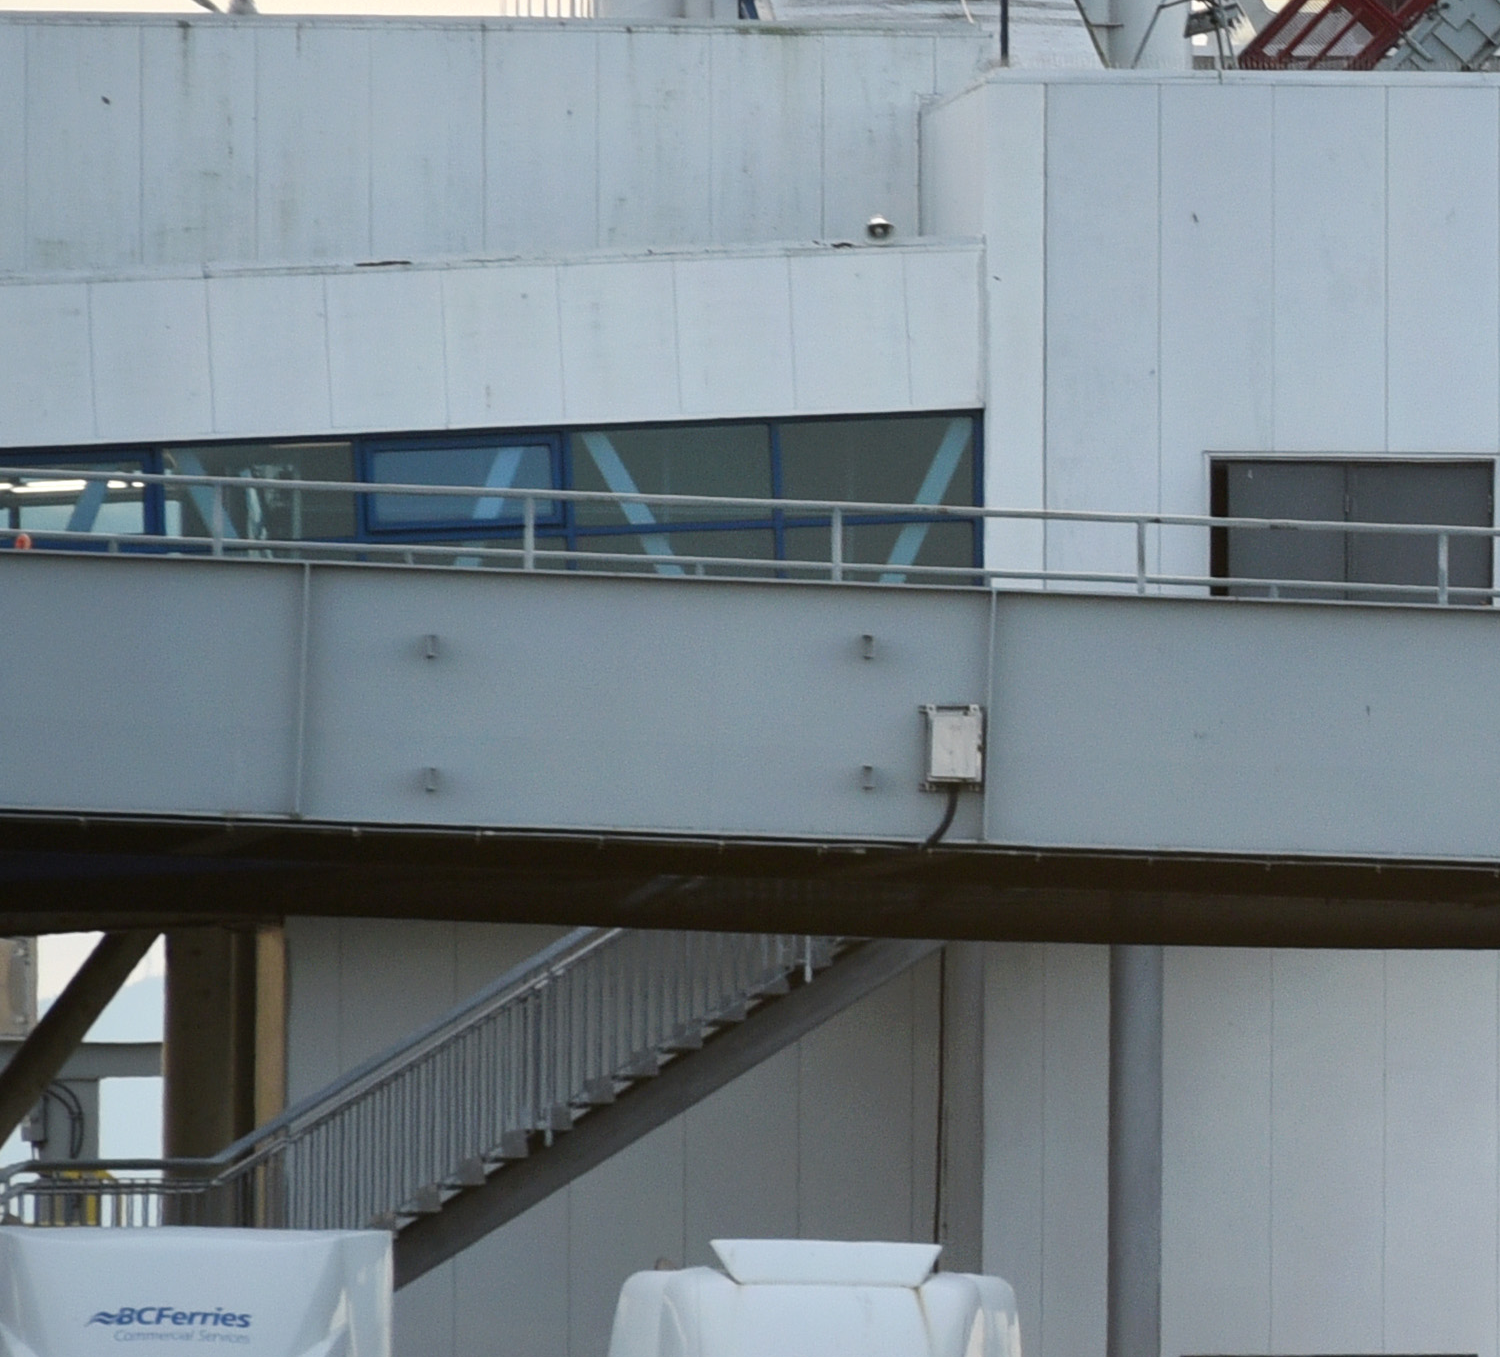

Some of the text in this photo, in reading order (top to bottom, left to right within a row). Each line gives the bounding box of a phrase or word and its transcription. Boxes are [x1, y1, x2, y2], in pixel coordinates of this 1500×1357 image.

[115, 1306, 252, 1329] BCFerries
[114, 1330, 251, 1344] Commercial Services
